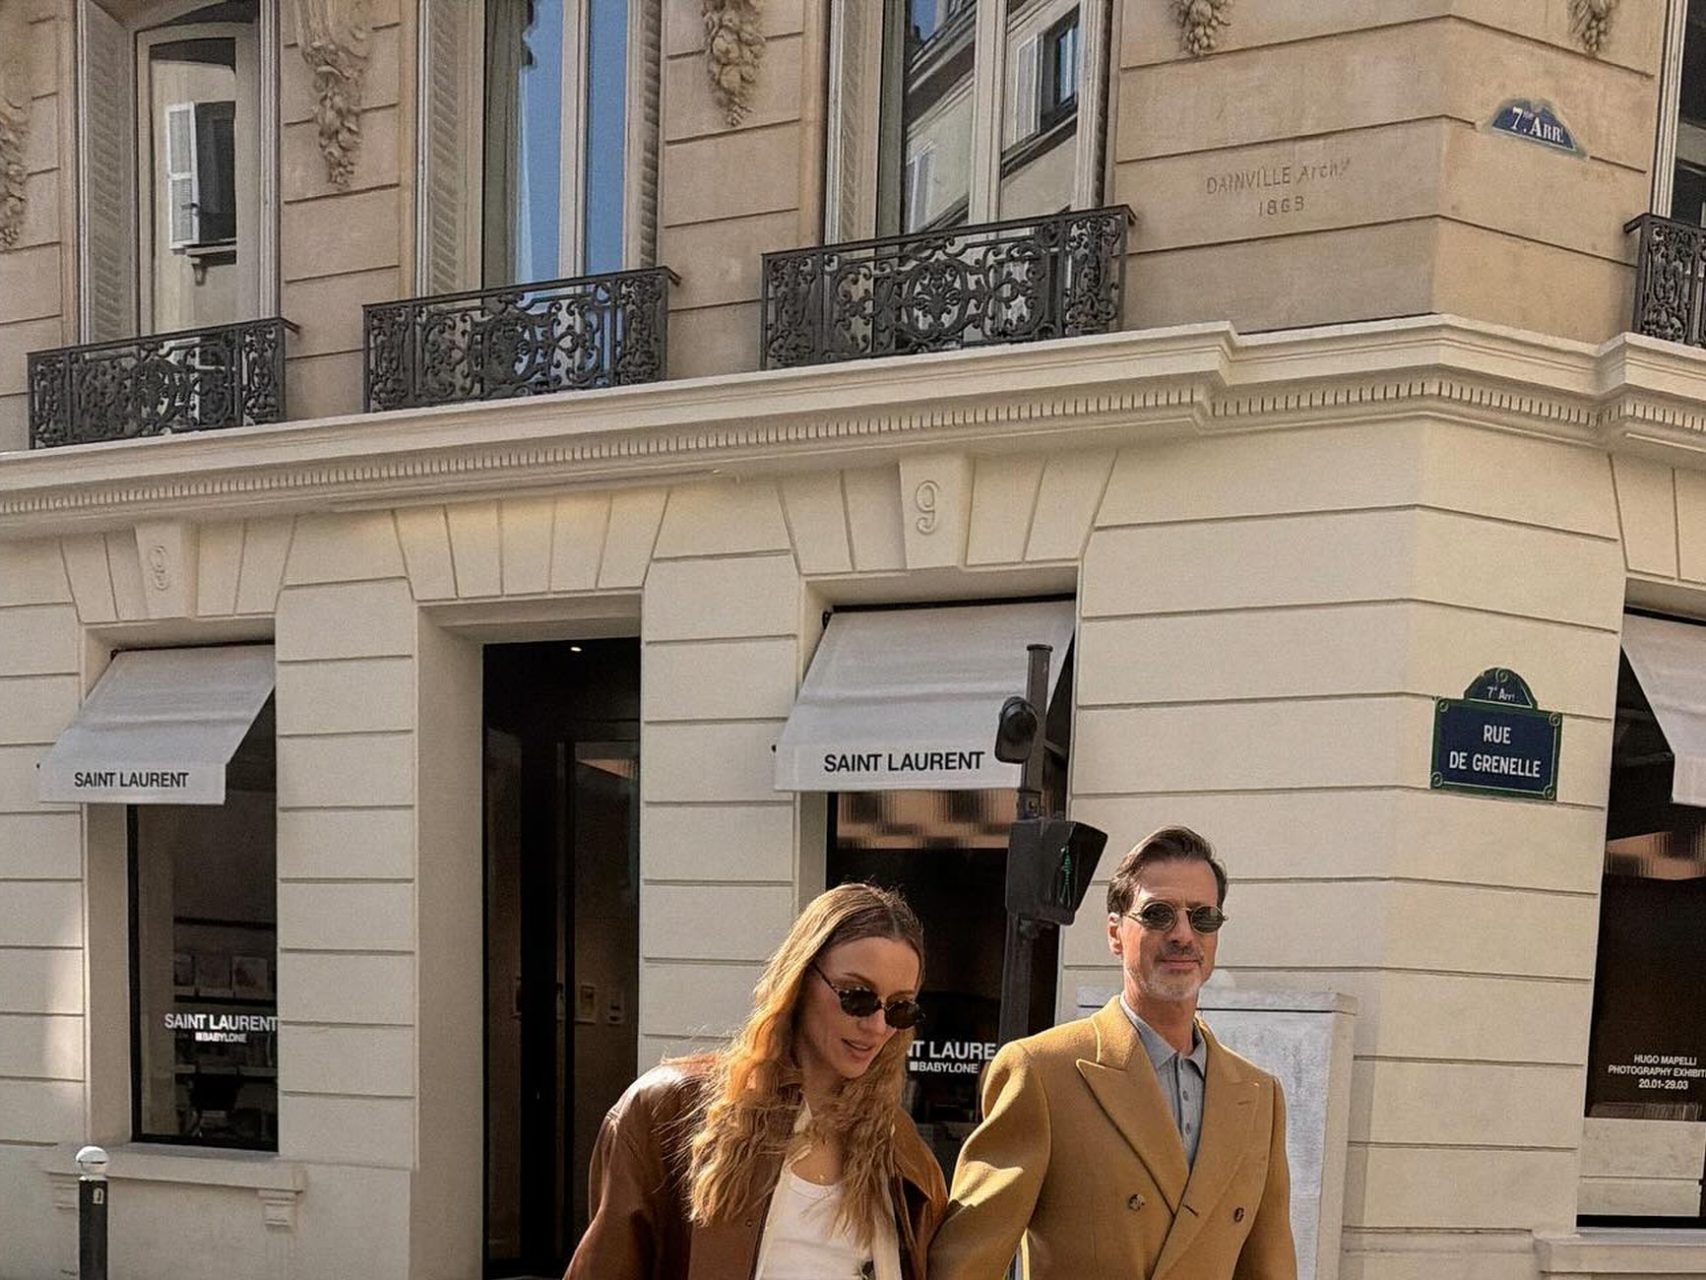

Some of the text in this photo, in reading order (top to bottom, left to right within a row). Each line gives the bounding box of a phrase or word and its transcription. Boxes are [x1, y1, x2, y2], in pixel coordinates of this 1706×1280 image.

[915, 480, 940, 535] 9
[1483, 724, 1511, 744] RUE
[824, 751, 985, 773] SAINT LAURENT
[1449, 751, 1541, 778] DE GRENELLE
[74, 772, 189, 788] SAINT LAURENT
[164, 1013, 278, 1031] SAINT LAURENT
[918, 1062, 979, 1074] BABYLONE
[1633, 1054, 1697, 1066] HUGO MAPELLI
[1608, 1064, 1672, 1075] PHOTOGRAPHY
[1638, 1078, 1689, 1090] 20.01-29.03
